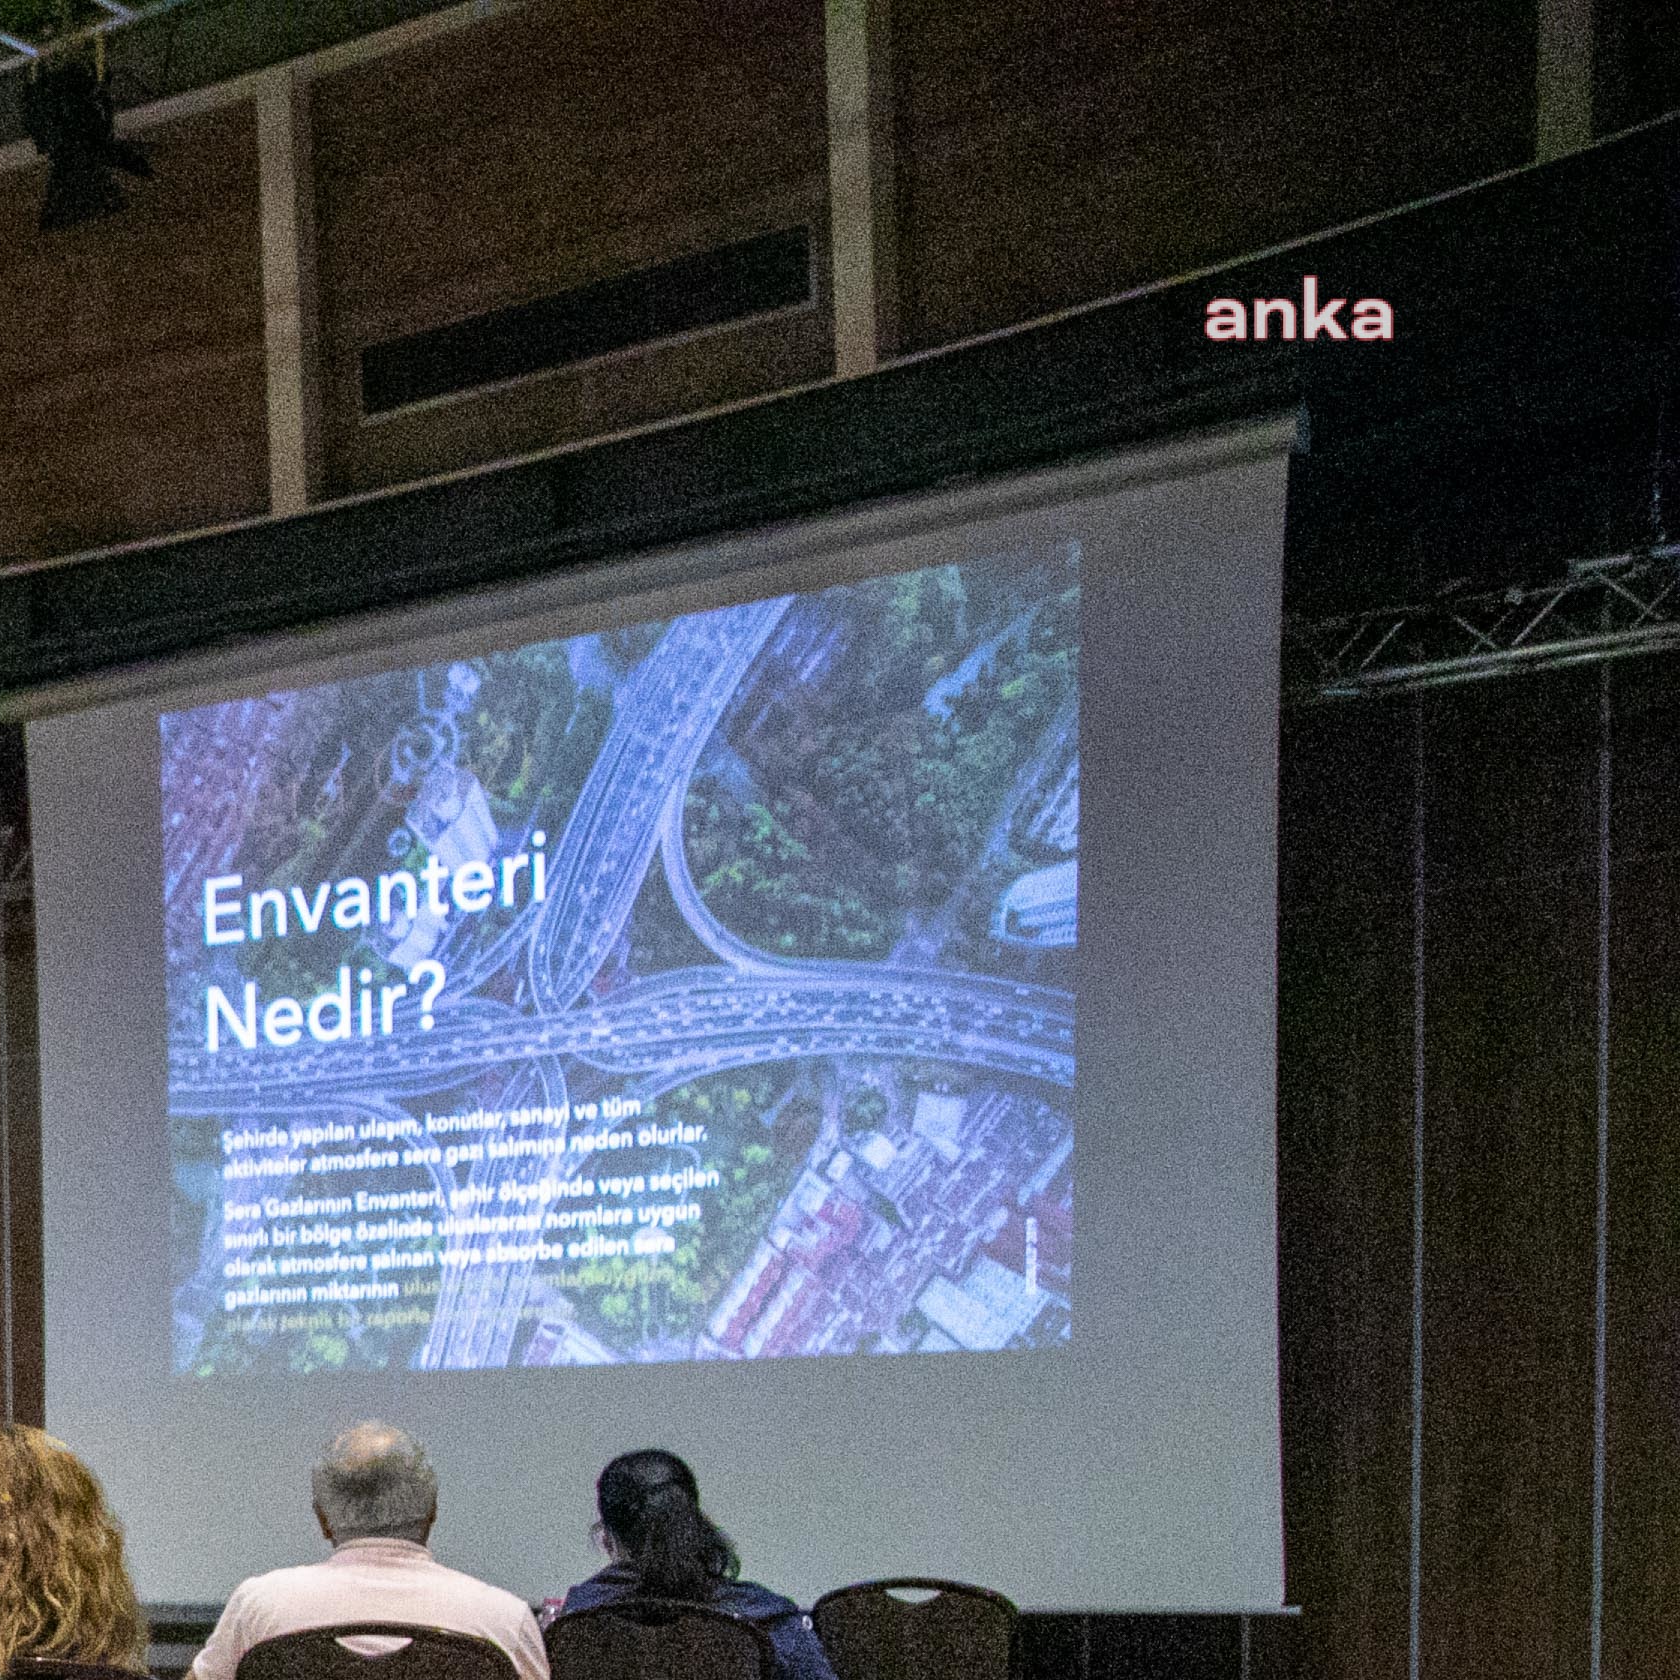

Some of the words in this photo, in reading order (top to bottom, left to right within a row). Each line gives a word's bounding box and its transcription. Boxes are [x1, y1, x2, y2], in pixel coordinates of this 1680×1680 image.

[203, 830, 546, 946] Envanteri
[206, 959, 446, 1051] Nedir?
[222, 1127, 289, 1153] Şehirde
[574, 1102, 598, 1120] ve
[602, 1096, 641, 1116] tüm
[311, 1148, 399, 1172] atmosfere
[402, 1147, 442, 1165] sera
[570, 1129, 634, 1151] neden
[638, 1121, 708, 1147] olurlar.
[224, 1200, 261, 1221] Sera
[598, 1174, 645, 1198] veya
[649, 1165, 720, 1194] seçilen
[272, 1226, 298, 1246] bir
[300, 1223, 352, 1247] bölge
[545, 1204, 632, 1229] normlara
[638, 1203, 701, 1228] uygun
[223, 1255, 277, 1278] olarak
[279, 1251, 367, 1275] atmosfere
[567, 1234, 630, 1258] edilen
